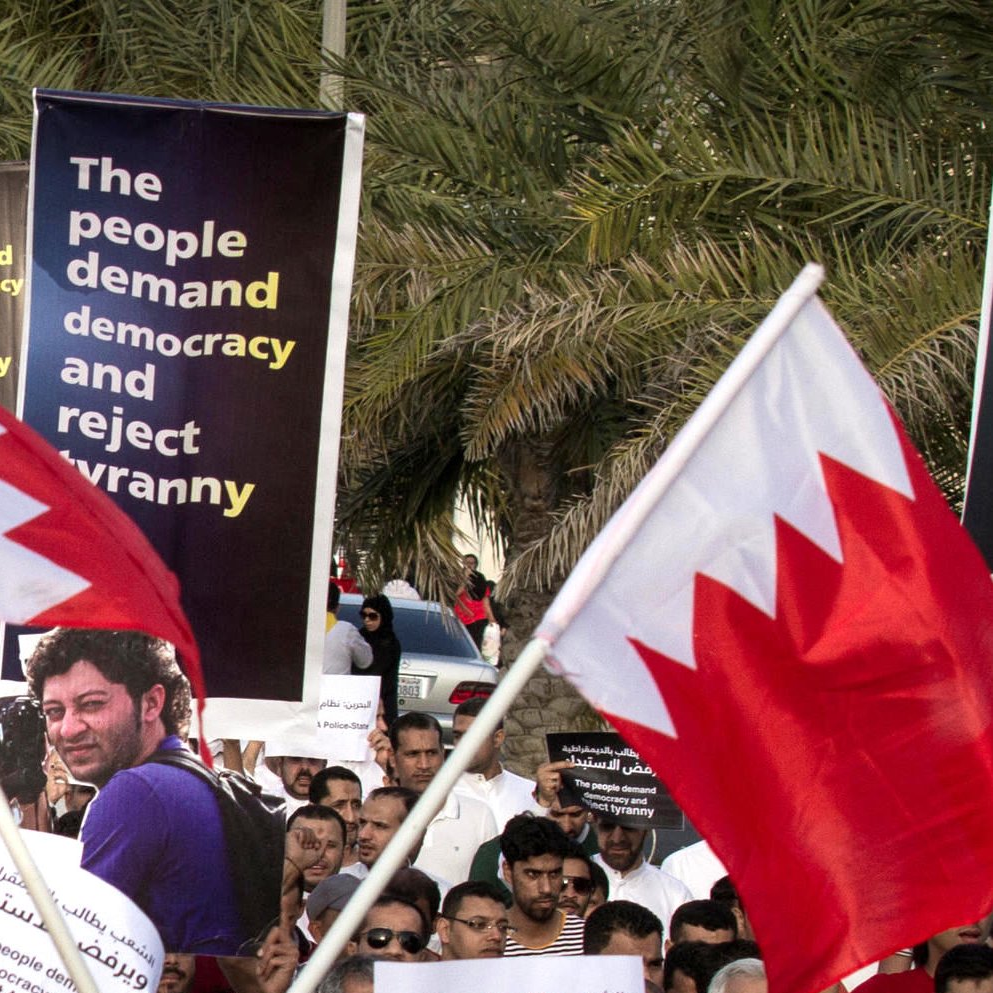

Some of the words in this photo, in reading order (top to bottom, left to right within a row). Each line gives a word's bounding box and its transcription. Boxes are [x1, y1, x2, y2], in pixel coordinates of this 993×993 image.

[69, 156, 162, 201] The
[69, 210, 248, 267] people
[66, 251, 279, 309] demand
[64, 305, 296, 370] democracy
[60, 356, 156, 401] and
[57, 405, 200, 457] reject
[575, 779, 590, 788] The
[592, 782, 620, 792] people
[621, 785, 656, 794] demand
[583, 792, 629, 805] democracy
[631, 797, 648, 805] and
[610, 804, 654, 818] tyranny
[62, 904, 107, 935] يطالب
[78, 939, 149, 991] ويرفض
